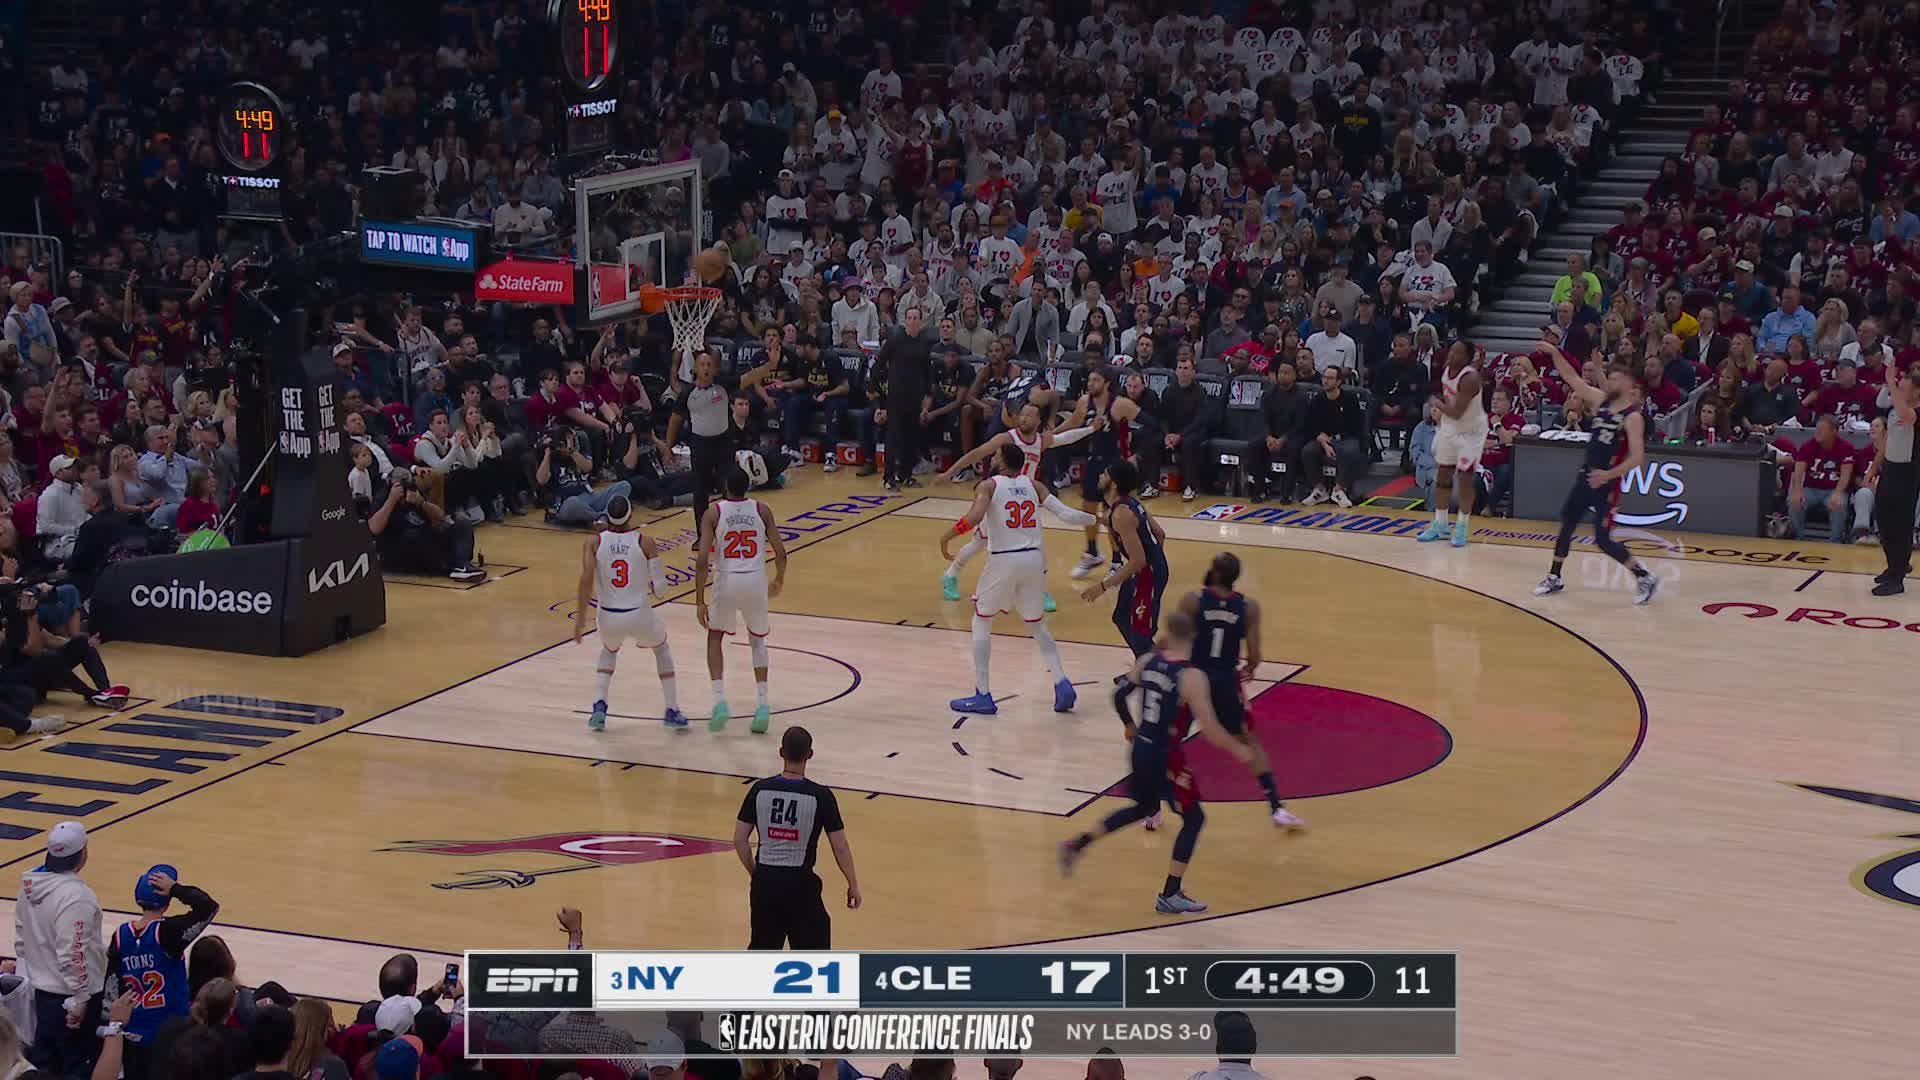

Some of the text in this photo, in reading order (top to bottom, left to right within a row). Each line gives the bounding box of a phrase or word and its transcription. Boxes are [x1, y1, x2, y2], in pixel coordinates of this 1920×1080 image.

[578, 0, 610, 22] 4:49
[584, 23, 609, 78] 11
[235, 110, 273, 131] 4:49
[243, 132, 269, 160] 11
[366, 229, 470, 263] TAP TO WATCH App
[282, 387, 303, 409] GET
[319, 384, 333, 407] GET
[283, 409, 305, 431] THE
[320, 406, 336, 429] THE
[290, 431, 312, 459] App
[325, 429, 340, 455] App
[321, 505, 346, 521] Google
[1005, 500, 1037, 529] 32
[724, 530, 757, 559] 25
[1473, 528, 1577, 543] Presente
[1621, 538, 1830, 565] Google
[308, 552, 370, 593] KIA
[611, 559, 629, 588] 3
[130, 579, 272, 615] coinbase
[1209, 628, 1225, 658] 1
[770, 797, 799, 827] 24
